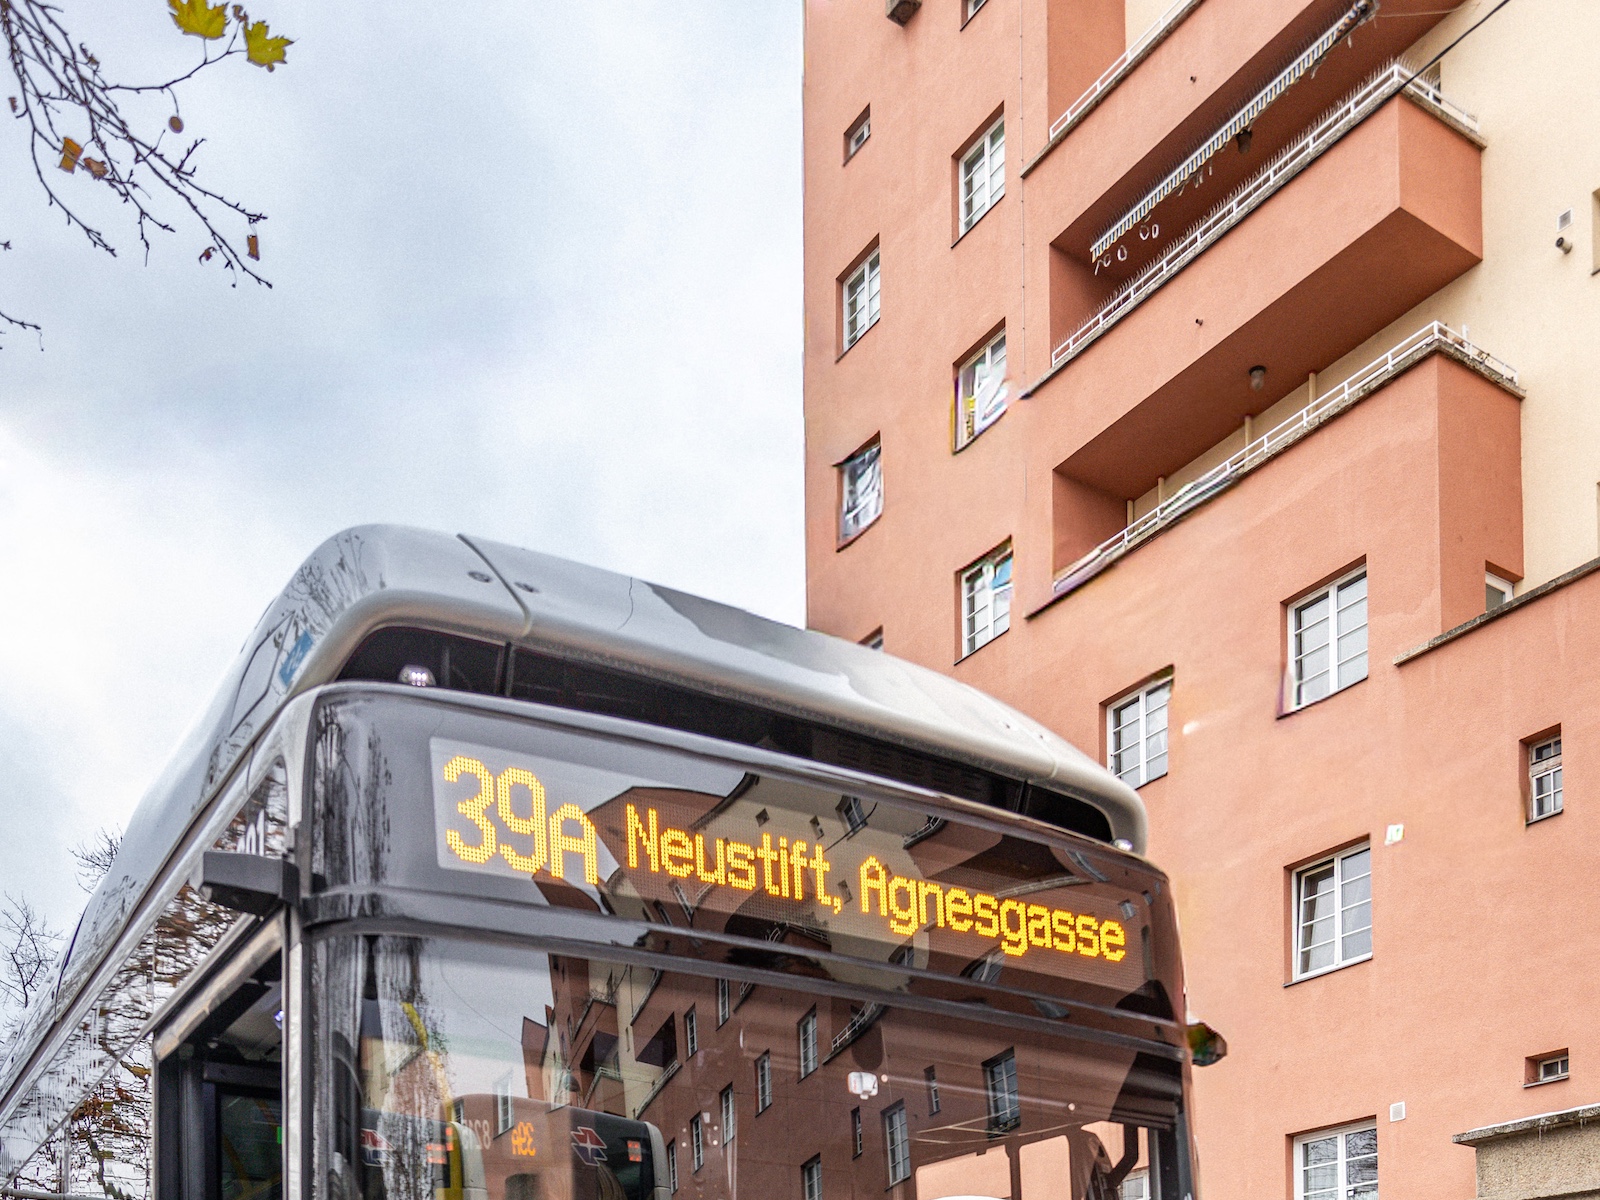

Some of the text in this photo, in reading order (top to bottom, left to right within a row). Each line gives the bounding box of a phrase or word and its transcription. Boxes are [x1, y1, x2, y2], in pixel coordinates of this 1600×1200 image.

[443, 755, 1126, 962] 39A Neustift, Agnesgasse
